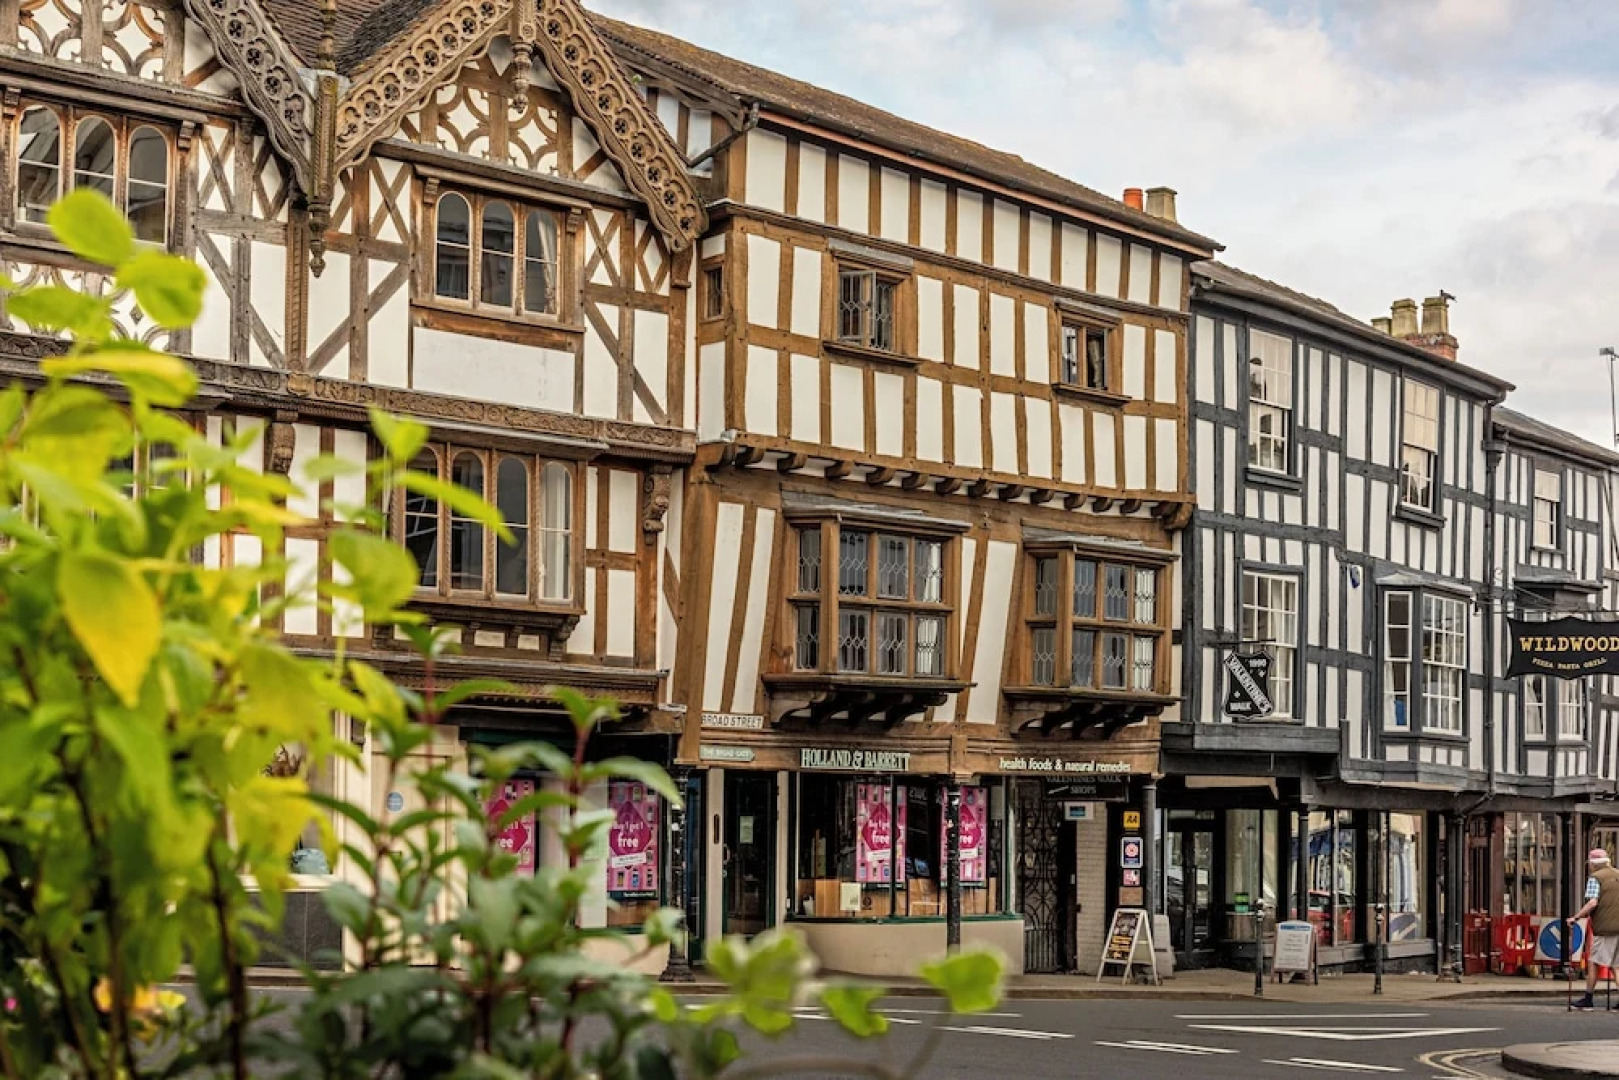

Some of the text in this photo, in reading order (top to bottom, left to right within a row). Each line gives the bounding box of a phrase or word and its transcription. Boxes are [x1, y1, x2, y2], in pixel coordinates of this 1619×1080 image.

[1519, 637, 1619, 652] WILDWOOD
[1532, 656, 1554, 668] PIZZA
[701, 714, 762, 728] BROAD STREET
[801, 748, 911, 771] HOLLAND & BARRETT
[999, 757, 1027, 769] health
[1028, 758, 1053, 770] foods
[1054, 759, 1063, 771] &
[1064, 760, 1095, 772] natural
[1070, 785, 1096, 794] SHOPS
[1127, 815, 1138, 823] AA
[618, 832, 639, 848] free
[872, 829, 890, 843] free
